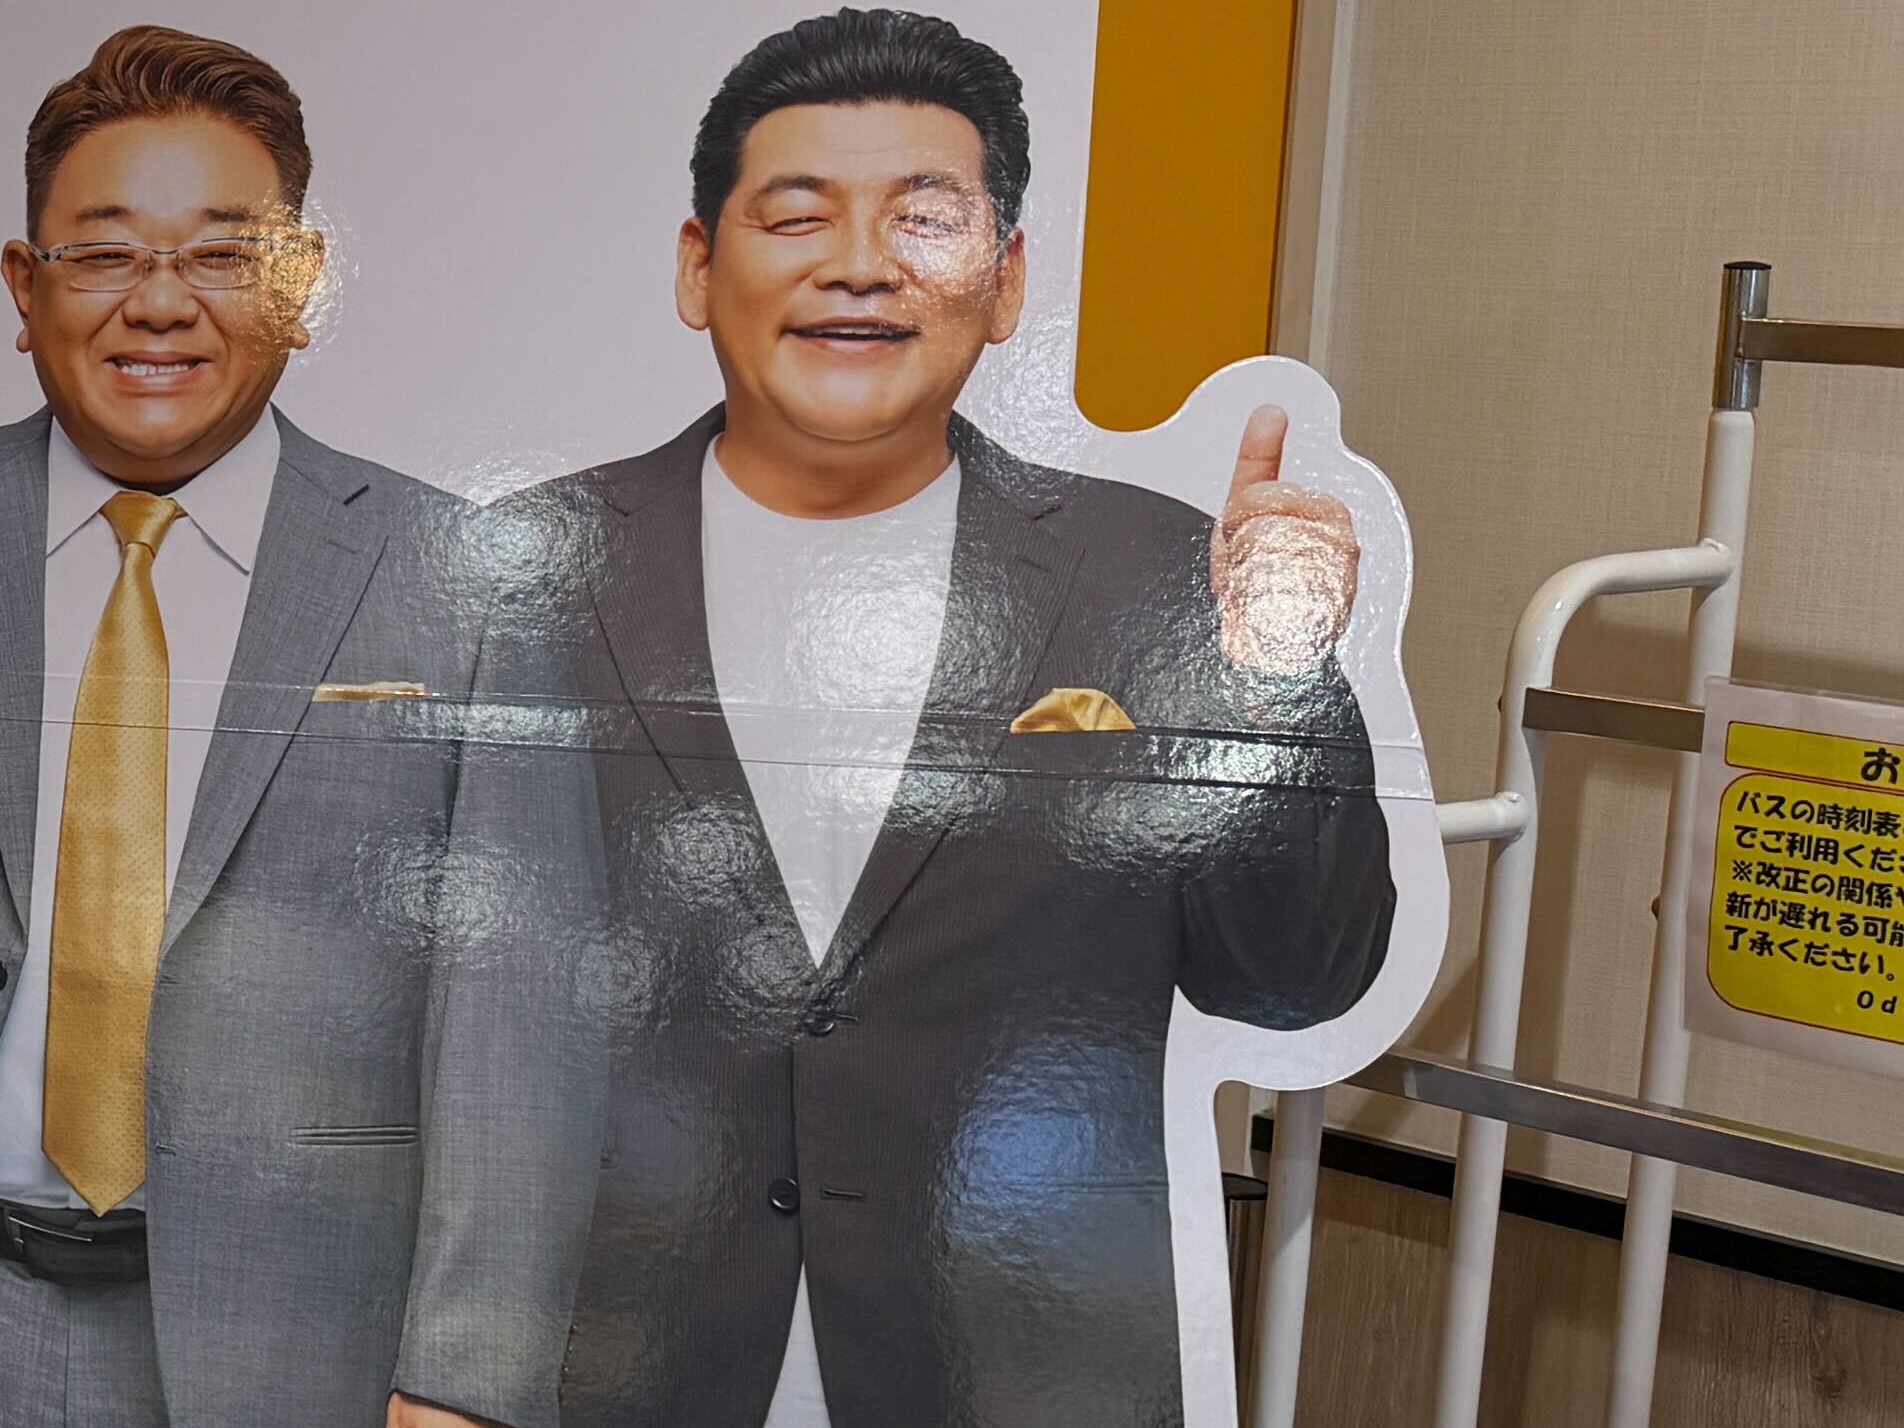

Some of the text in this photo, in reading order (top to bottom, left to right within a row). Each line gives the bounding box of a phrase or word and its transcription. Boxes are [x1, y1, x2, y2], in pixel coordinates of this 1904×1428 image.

[1860, 746, 1901, 785] お
[1732, 823, 1904, 874] でご利用くだ
[1723, 926, 1897, 982] 了承ください。
